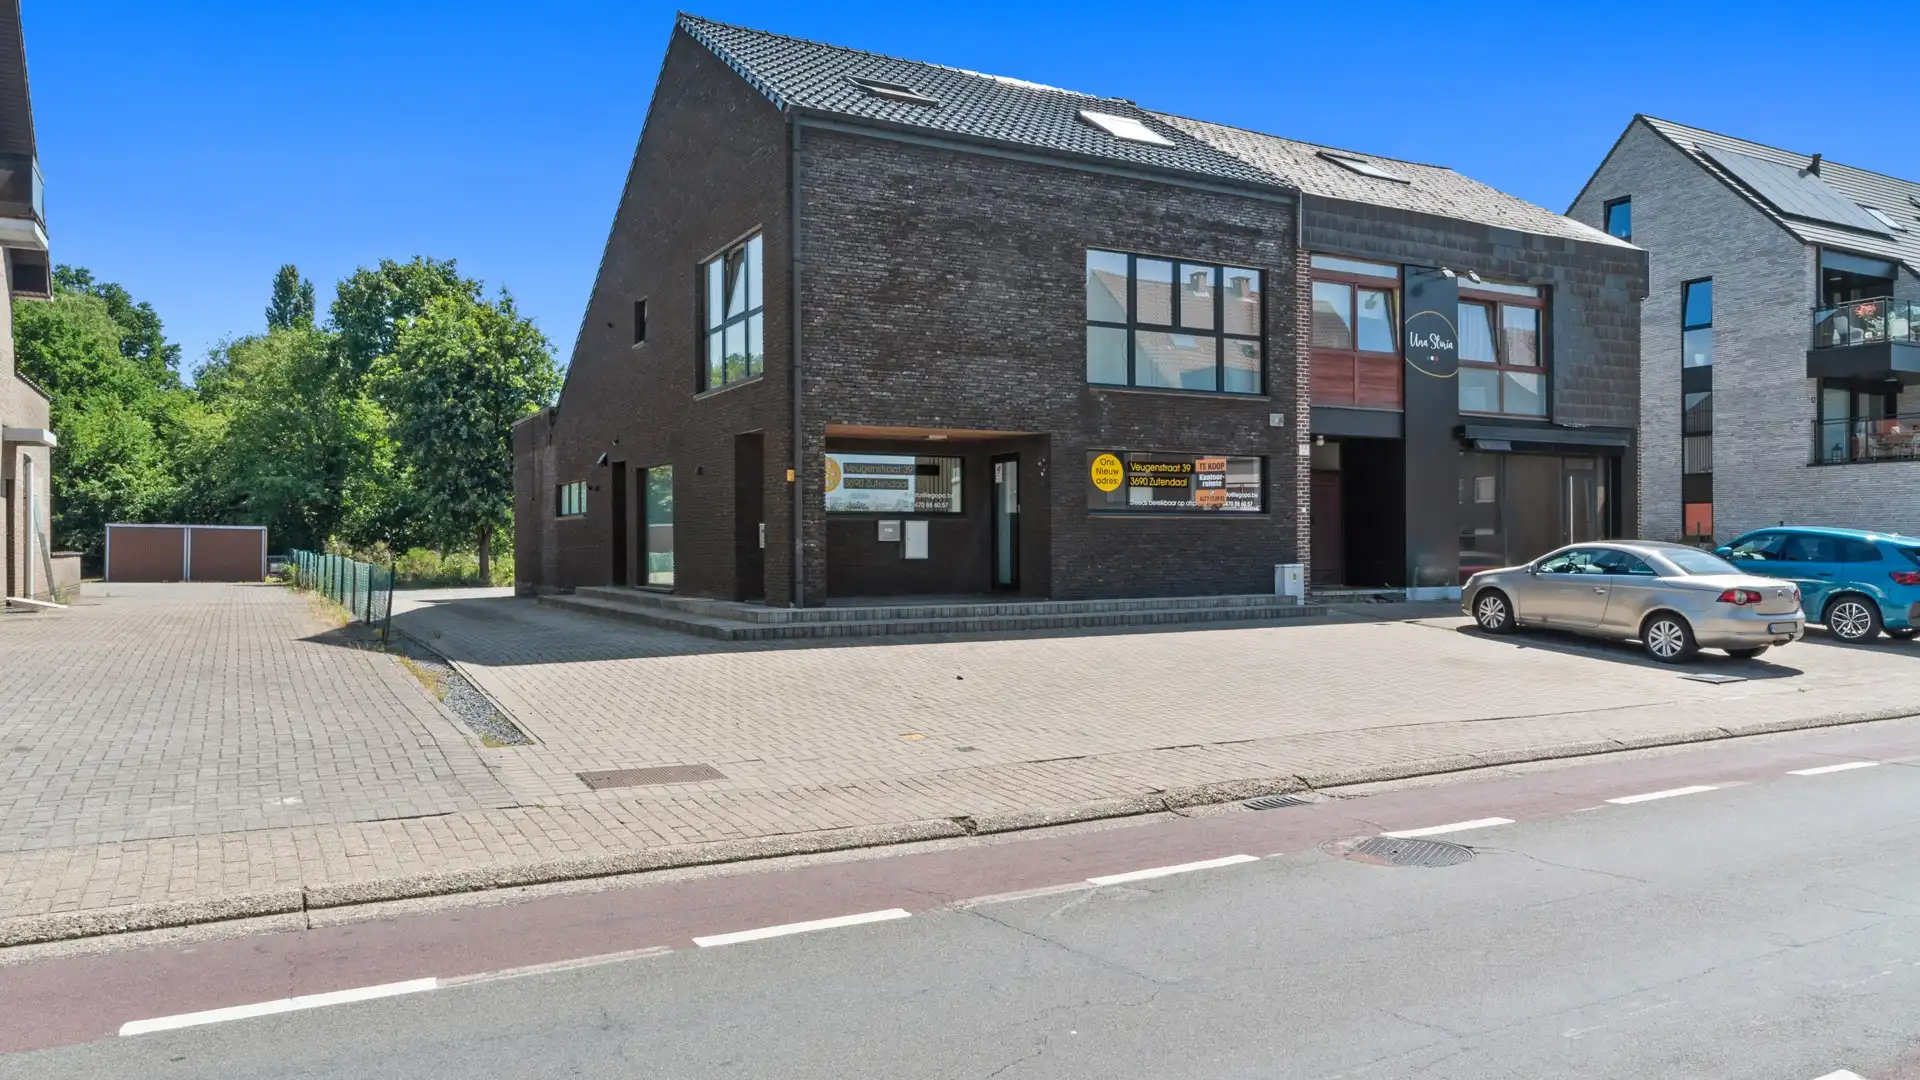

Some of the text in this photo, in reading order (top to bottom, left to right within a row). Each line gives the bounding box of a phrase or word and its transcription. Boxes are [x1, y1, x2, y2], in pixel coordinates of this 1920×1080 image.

[1410, 331, 1453, 350] Una Storia
[1100, 458, 1115, 466] Ons
[1199, 462, 1225, 471] TE KOOP
[903, 465, 913, 473] 39
[1096, 467, 1119, 475] Nieuw
[1130, 463, 1191, 473] Veugenstraat 39
[1130, 477, 1187, 487] 3690 Zutendaal
